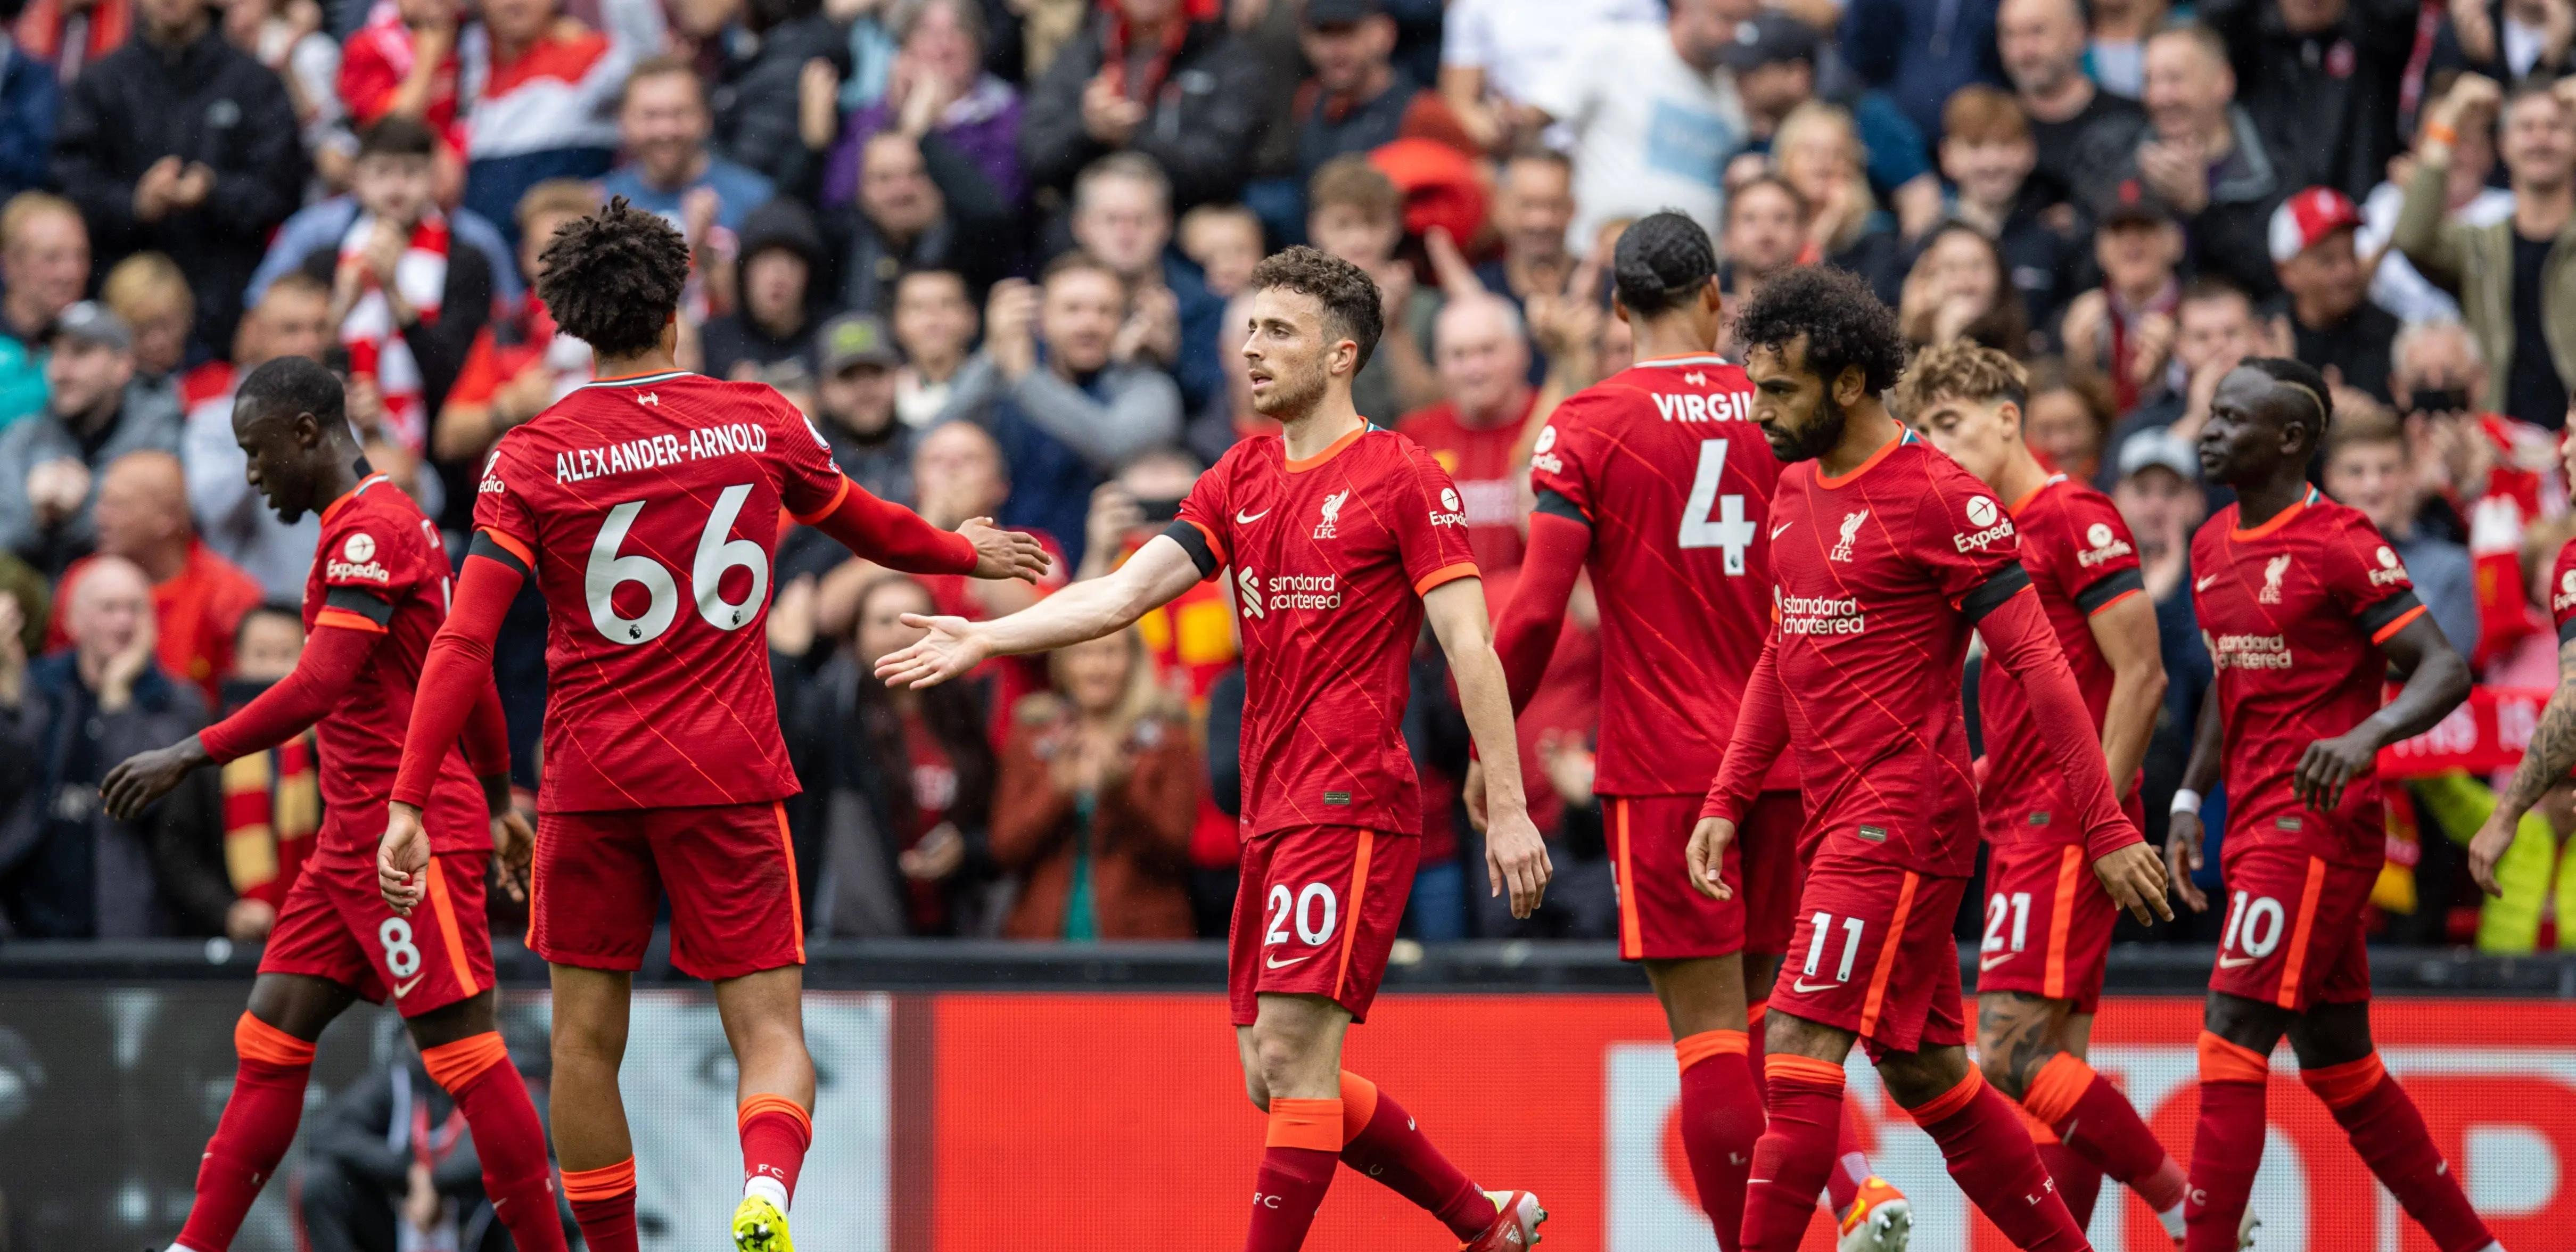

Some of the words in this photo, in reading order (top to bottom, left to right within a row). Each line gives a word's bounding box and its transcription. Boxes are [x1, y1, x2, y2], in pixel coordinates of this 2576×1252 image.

[479, 474, 505, 493] edia
[556, 423, 767, 484] ALEXANDER-ARNOLD
[1678, 439, 1756, 575] 4
[1953, 518, 2015, 553] Expedi
[585, 483, 769, 645] 66
[1783, 594, 1856, 616] standard
[1783, 614, 1864, 635] chartered
[1264, 883, 1336, 946] 20
[1980, 893, 2031, 953] 21
[2224, 891, 2284, 958] 10
[379, 917, 421, 978] 8
[1805, 912, 1865, 982] 11
